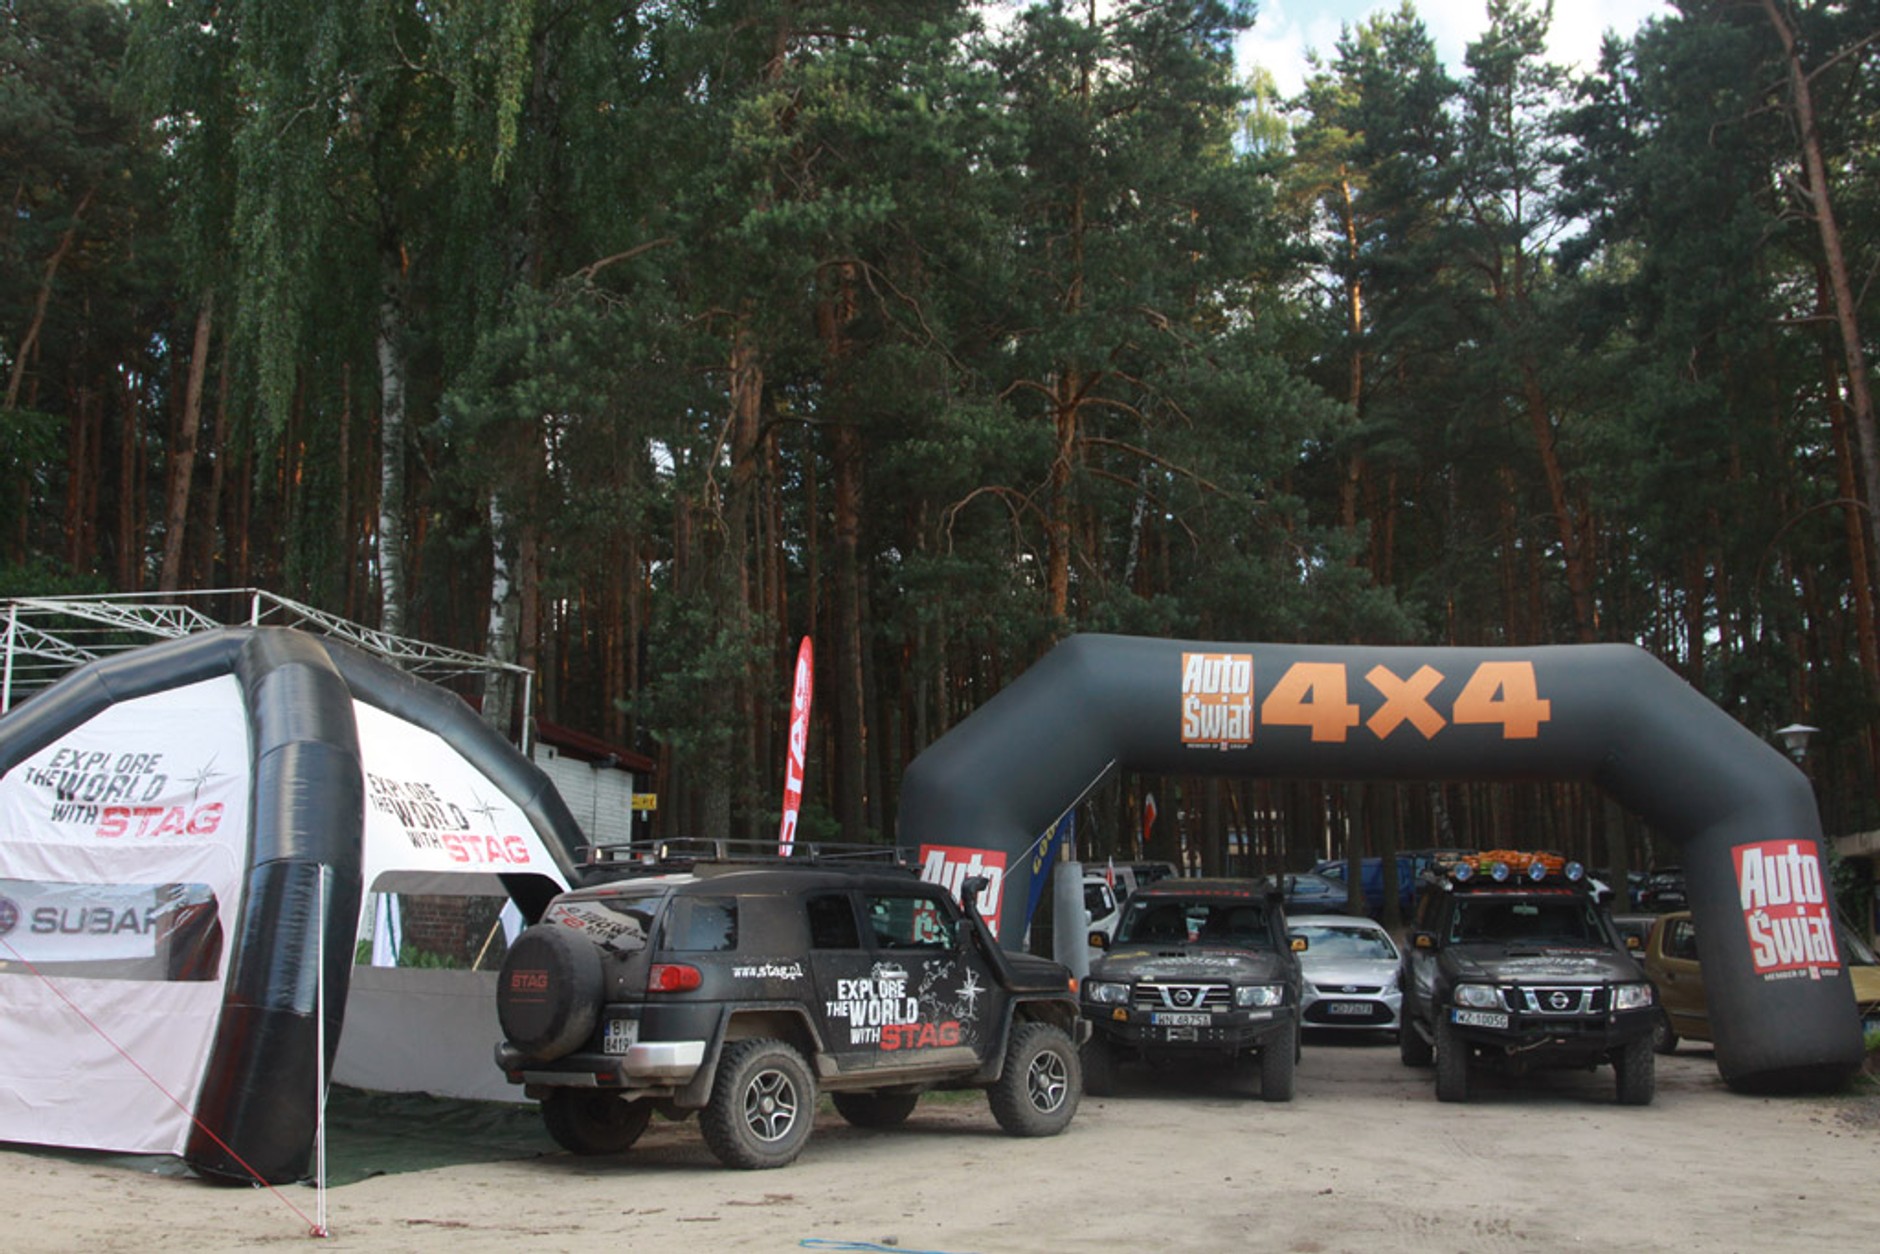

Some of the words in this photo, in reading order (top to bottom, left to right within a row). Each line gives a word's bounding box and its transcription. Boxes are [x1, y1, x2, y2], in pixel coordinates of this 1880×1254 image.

[1182, 654, 1250, 694] Auto
[1184, 694, 1251, 739] Świat
[50, 748, 163, 775] EXPLORE
[24, 767, 59, 787] THE
[56, 771, 168, 803] WORLD
[367, 773, 441, 802] EXPLORE
[51, 803, 98, 825] WITH
[96, 802, 224, 838] STAG
[369, 794, 393, 814] THE
[388, 798, 470, 831] WORLD
[406, 830, 443, 849] WITH
[441, 834, 530, 864] STAG
[1740, 843, 1823, 911] Auto
[1748, 906, 1838, 967] Świat
[512, 975, 548, 988] STAG
[837, 979, 906, 999] EXPLORE
[826, 1001, 848, 1017] THE
[850, 998, 919, 1026] WORLD
[850, 1028, 881, 1044] WITH
[880, 1021, 960, 1050] STAG
